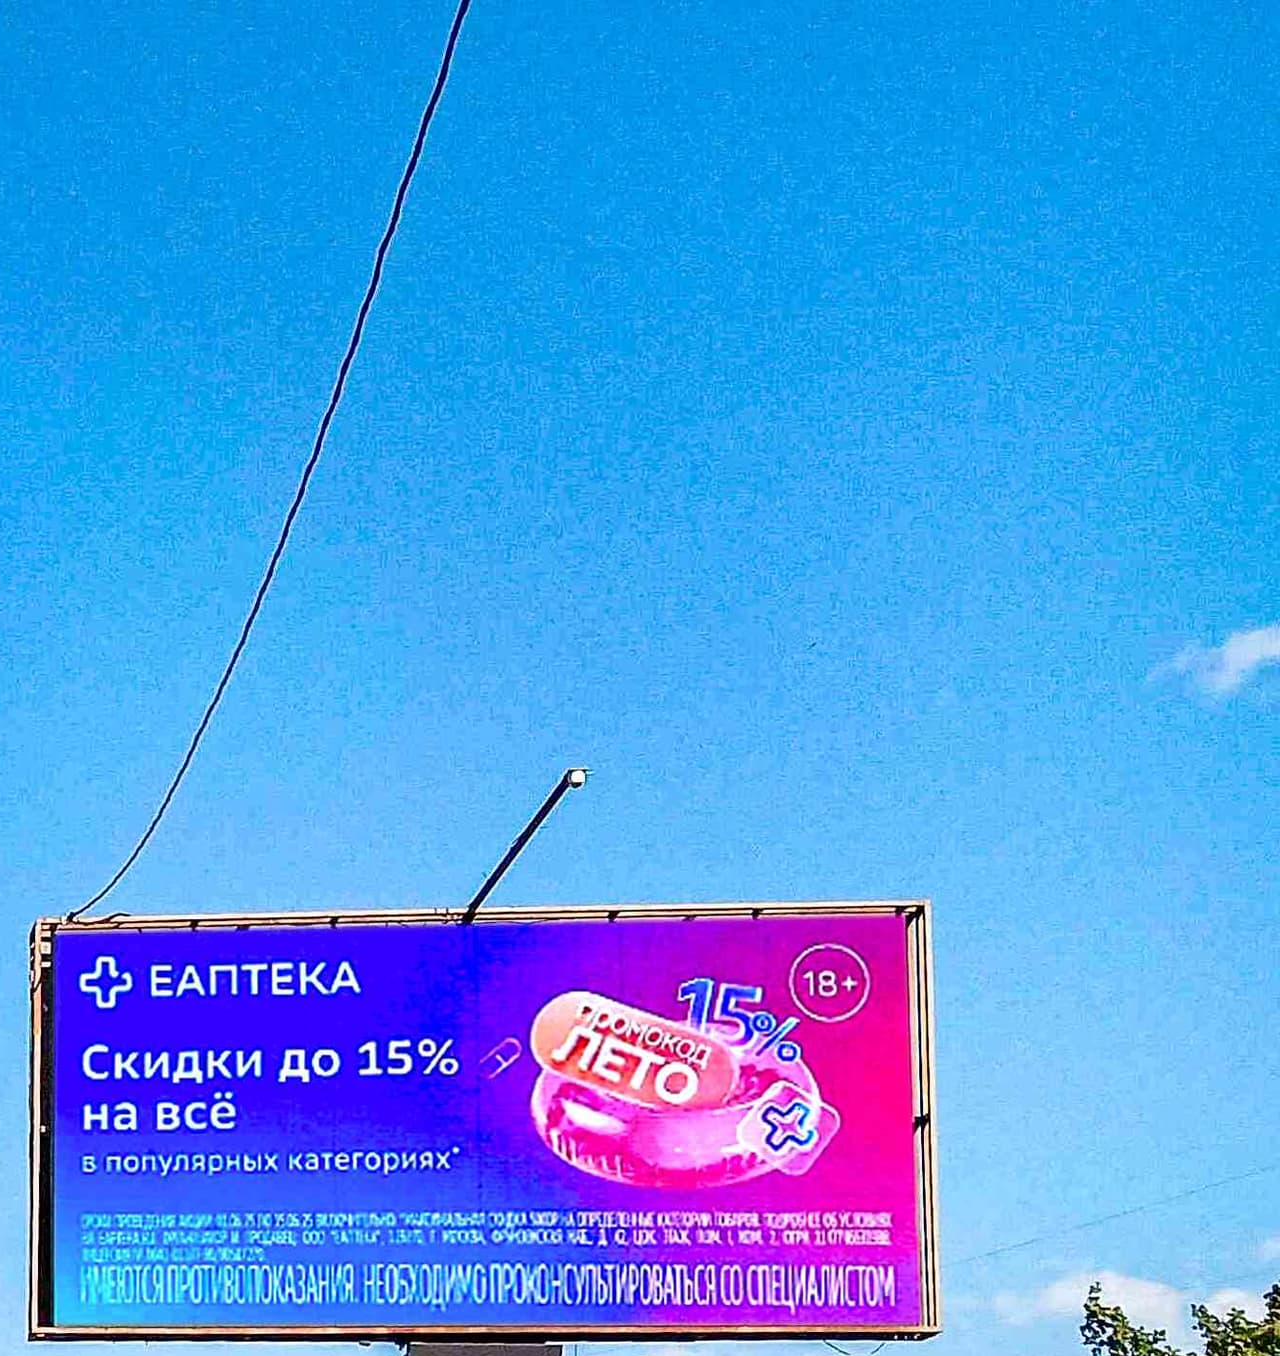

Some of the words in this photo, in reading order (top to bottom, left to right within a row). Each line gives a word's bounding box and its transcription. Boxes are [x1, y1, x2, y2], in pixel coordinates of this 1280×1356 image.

[149, 960, 362, 998] ЕАПТЕКА
[802, 970, 860, 998] 18+
[678, 977, 804, 1063] 15%
[81, 1043, 264, 1085] Скидки
[278, 1048, 341, 1083] до
[356, 1037, 461, 1077] 15%
[551, 1027, 700, 1105] ЛЕТО
[81, 1101, 138, 1131] на
[155, 1091, 238, 1131] всё
[81, 1153, 98, 1173] в
[105, 1151, 280, 1177] популярных
[80, 1263, 165, 1305] ИМЕЮТСЯ
[490, 1262, 717, 1306] ПРОКОНСУЛЬТИРОВАТЬСЯ
[720, 1264, 744, 1306] СО
[746, 1263, 896, 1315] СПЕЦИАЛИСТОМ
